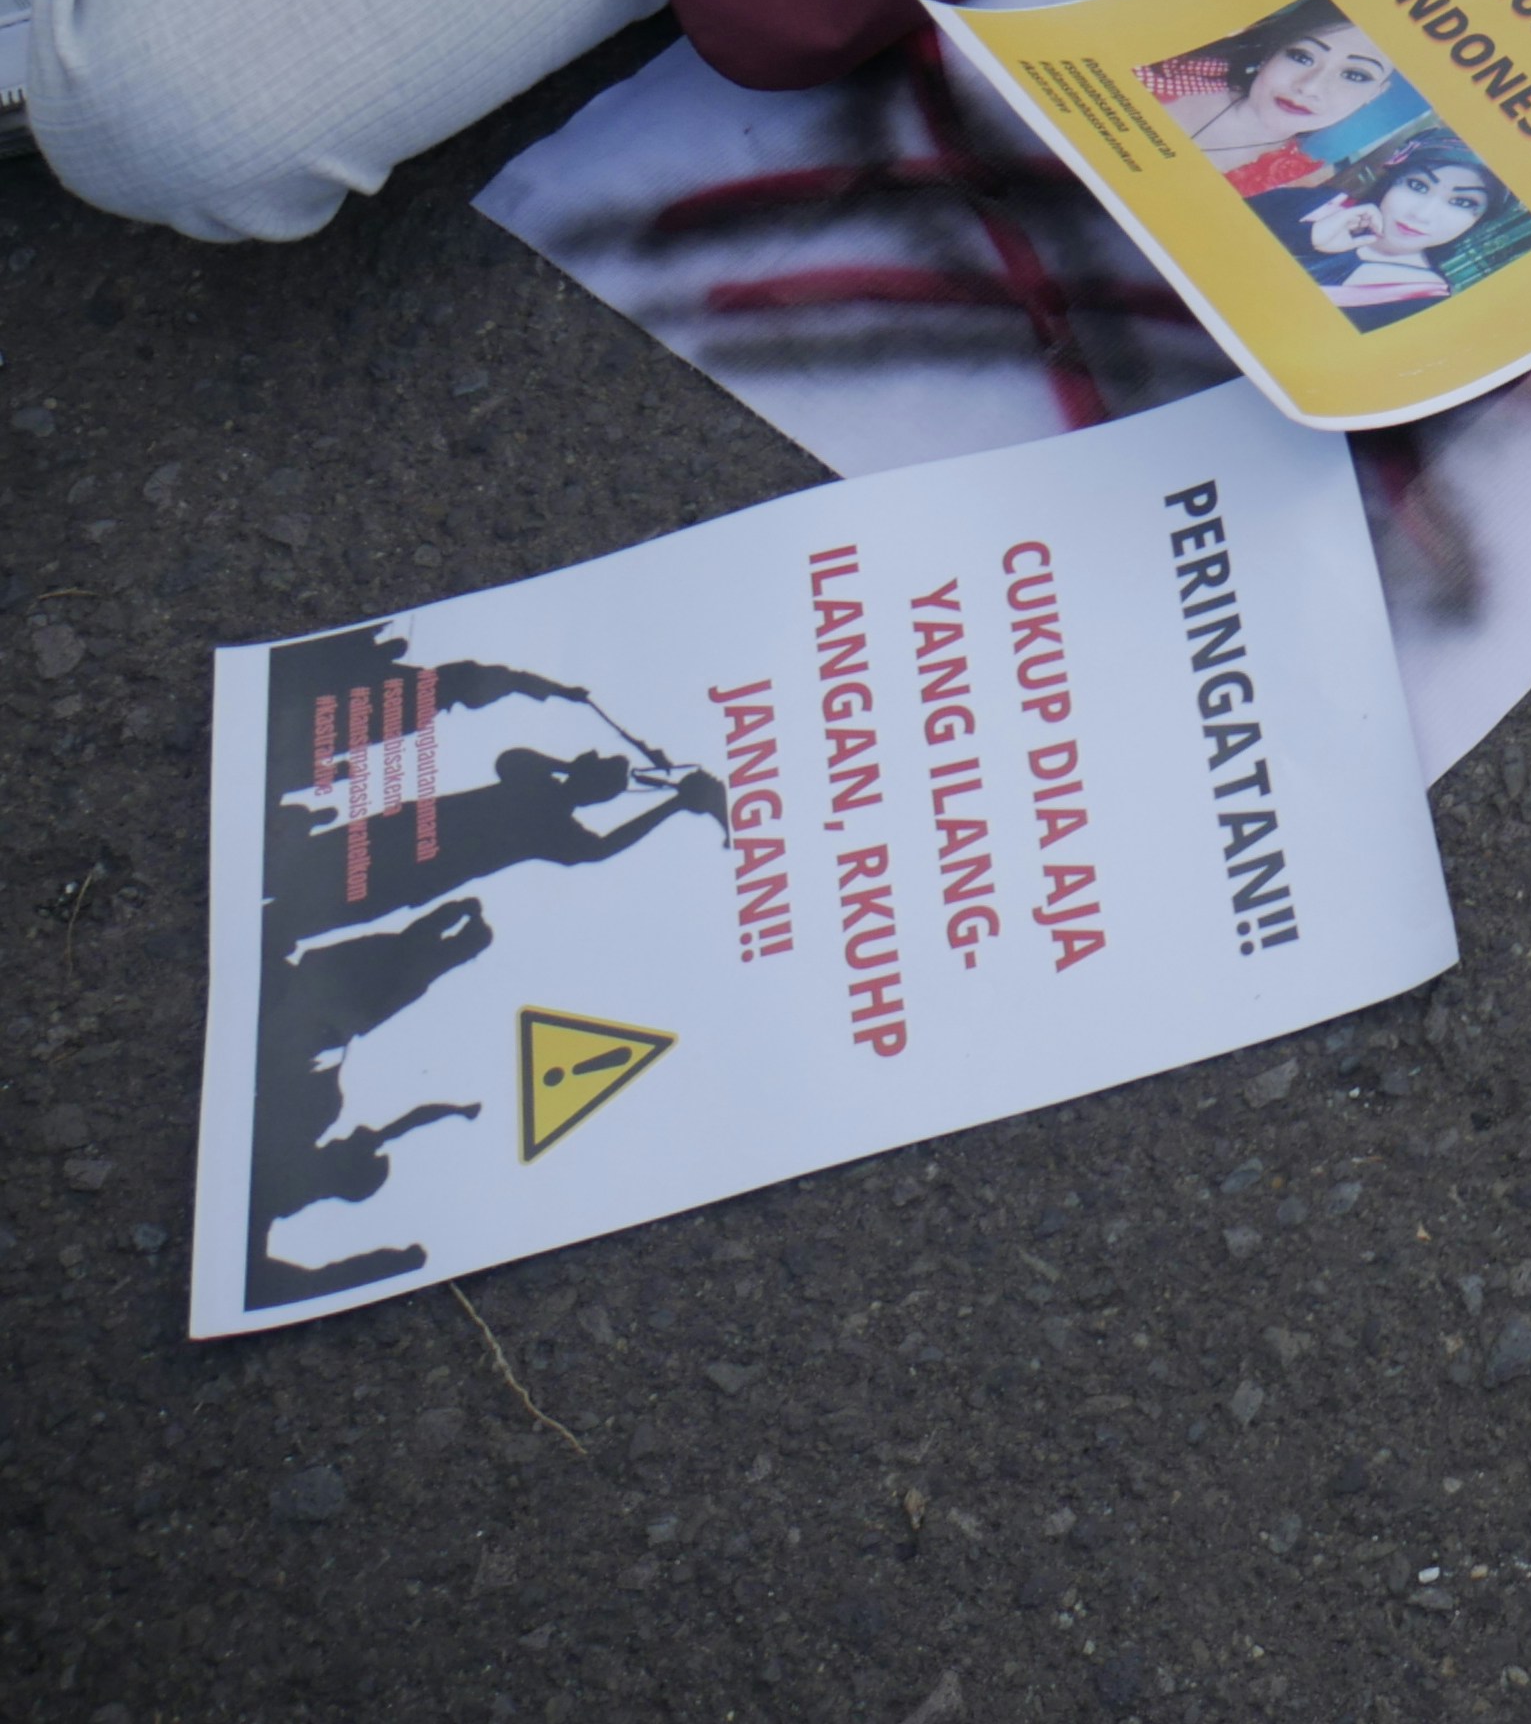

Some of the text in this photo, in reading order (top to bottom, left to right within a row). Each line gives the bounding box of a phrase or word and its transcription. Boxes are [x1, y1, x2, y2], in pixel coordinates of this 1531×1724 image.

[345, 683, 372, 904] #aliansimahasiswatelkom
[380, 674, 406, 819] #semuabisakena
[414, 666, 440, 864] #bandunglautanamarah
[708, 678, 794, 962] JANGAN!!
[808, 543, 907, 1057] ILANGAN, RKUHP
[910, 579, 1001, 968] YANG ILANG-
[1002, 539, 1106, 970] CUKUP DIA AJA
[1162, 478, 1299, 956] PERINGATAN!!
